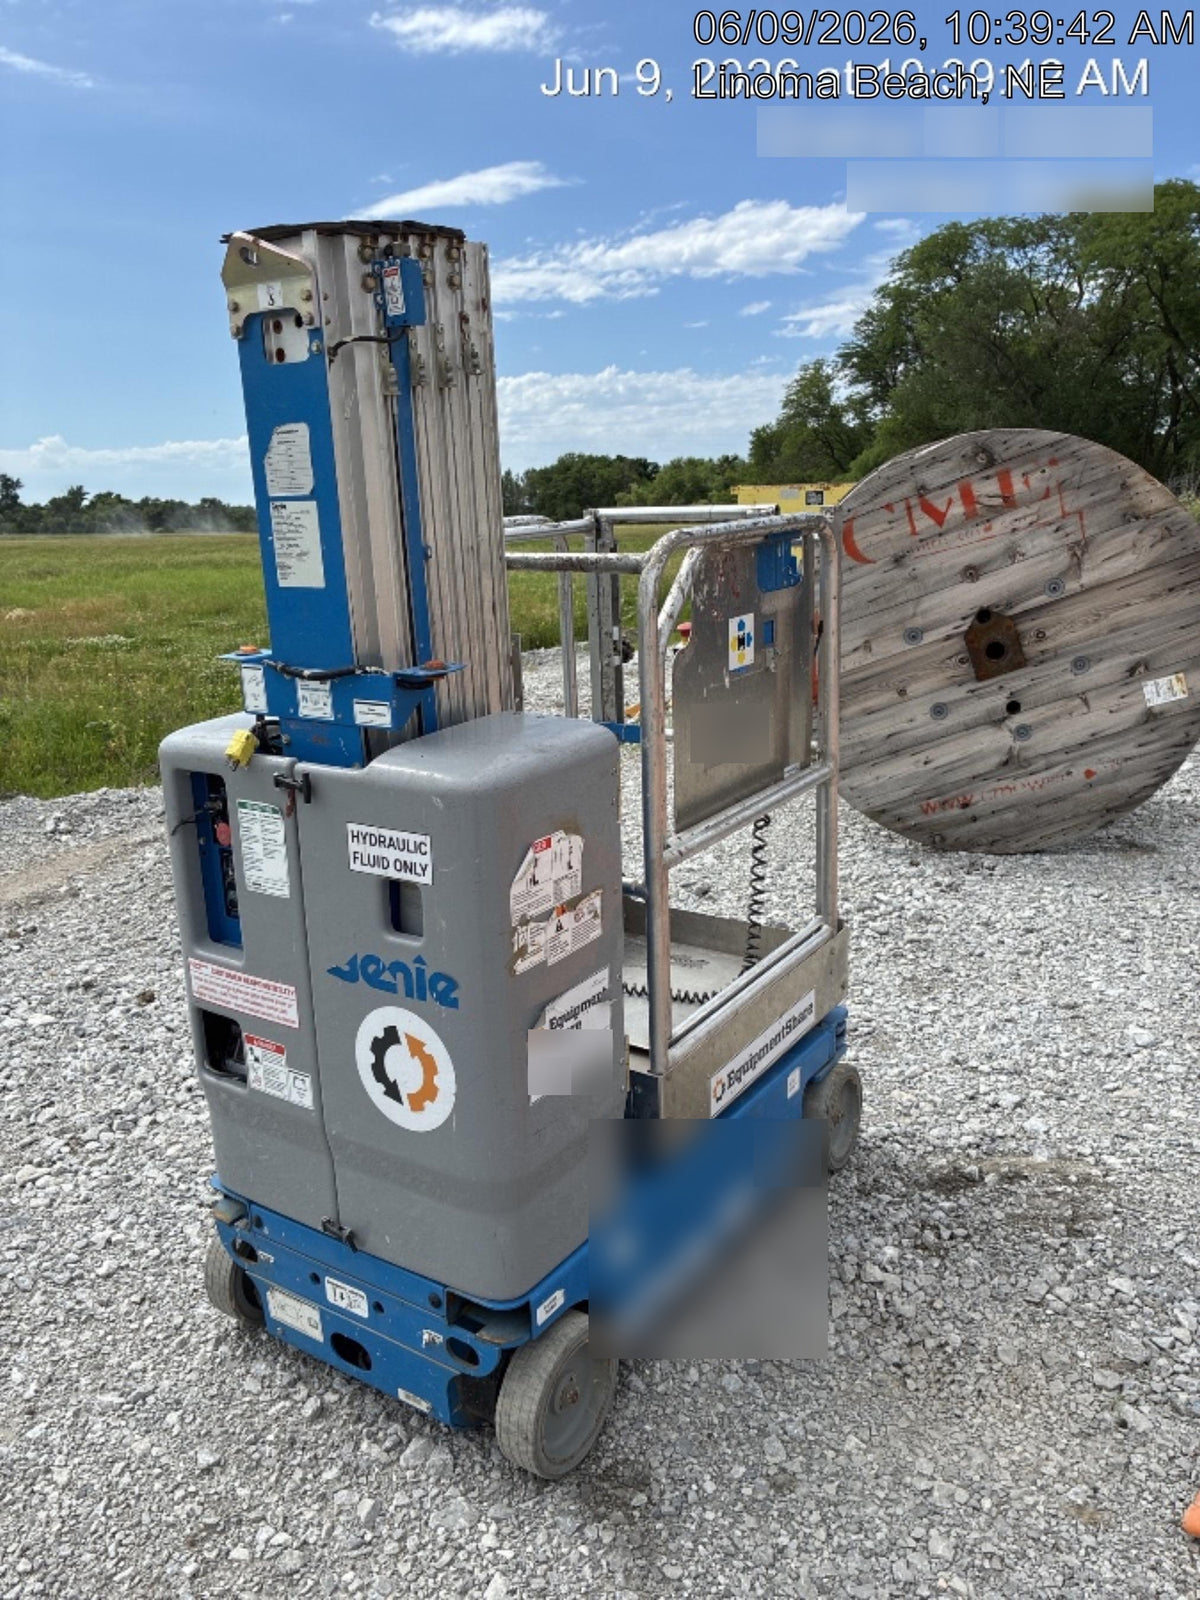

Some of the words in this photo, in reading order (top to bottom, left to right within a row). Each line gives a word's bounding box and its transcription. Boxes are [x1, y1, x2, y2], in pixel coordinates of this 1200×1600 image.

[350, 829, 428, 856] HYDRAULIC
[352, 850, 390, 871] FLUID
[393, 857, 429, 878] ONLY
[727, 1002, 814, 1090] EquipmentShare
